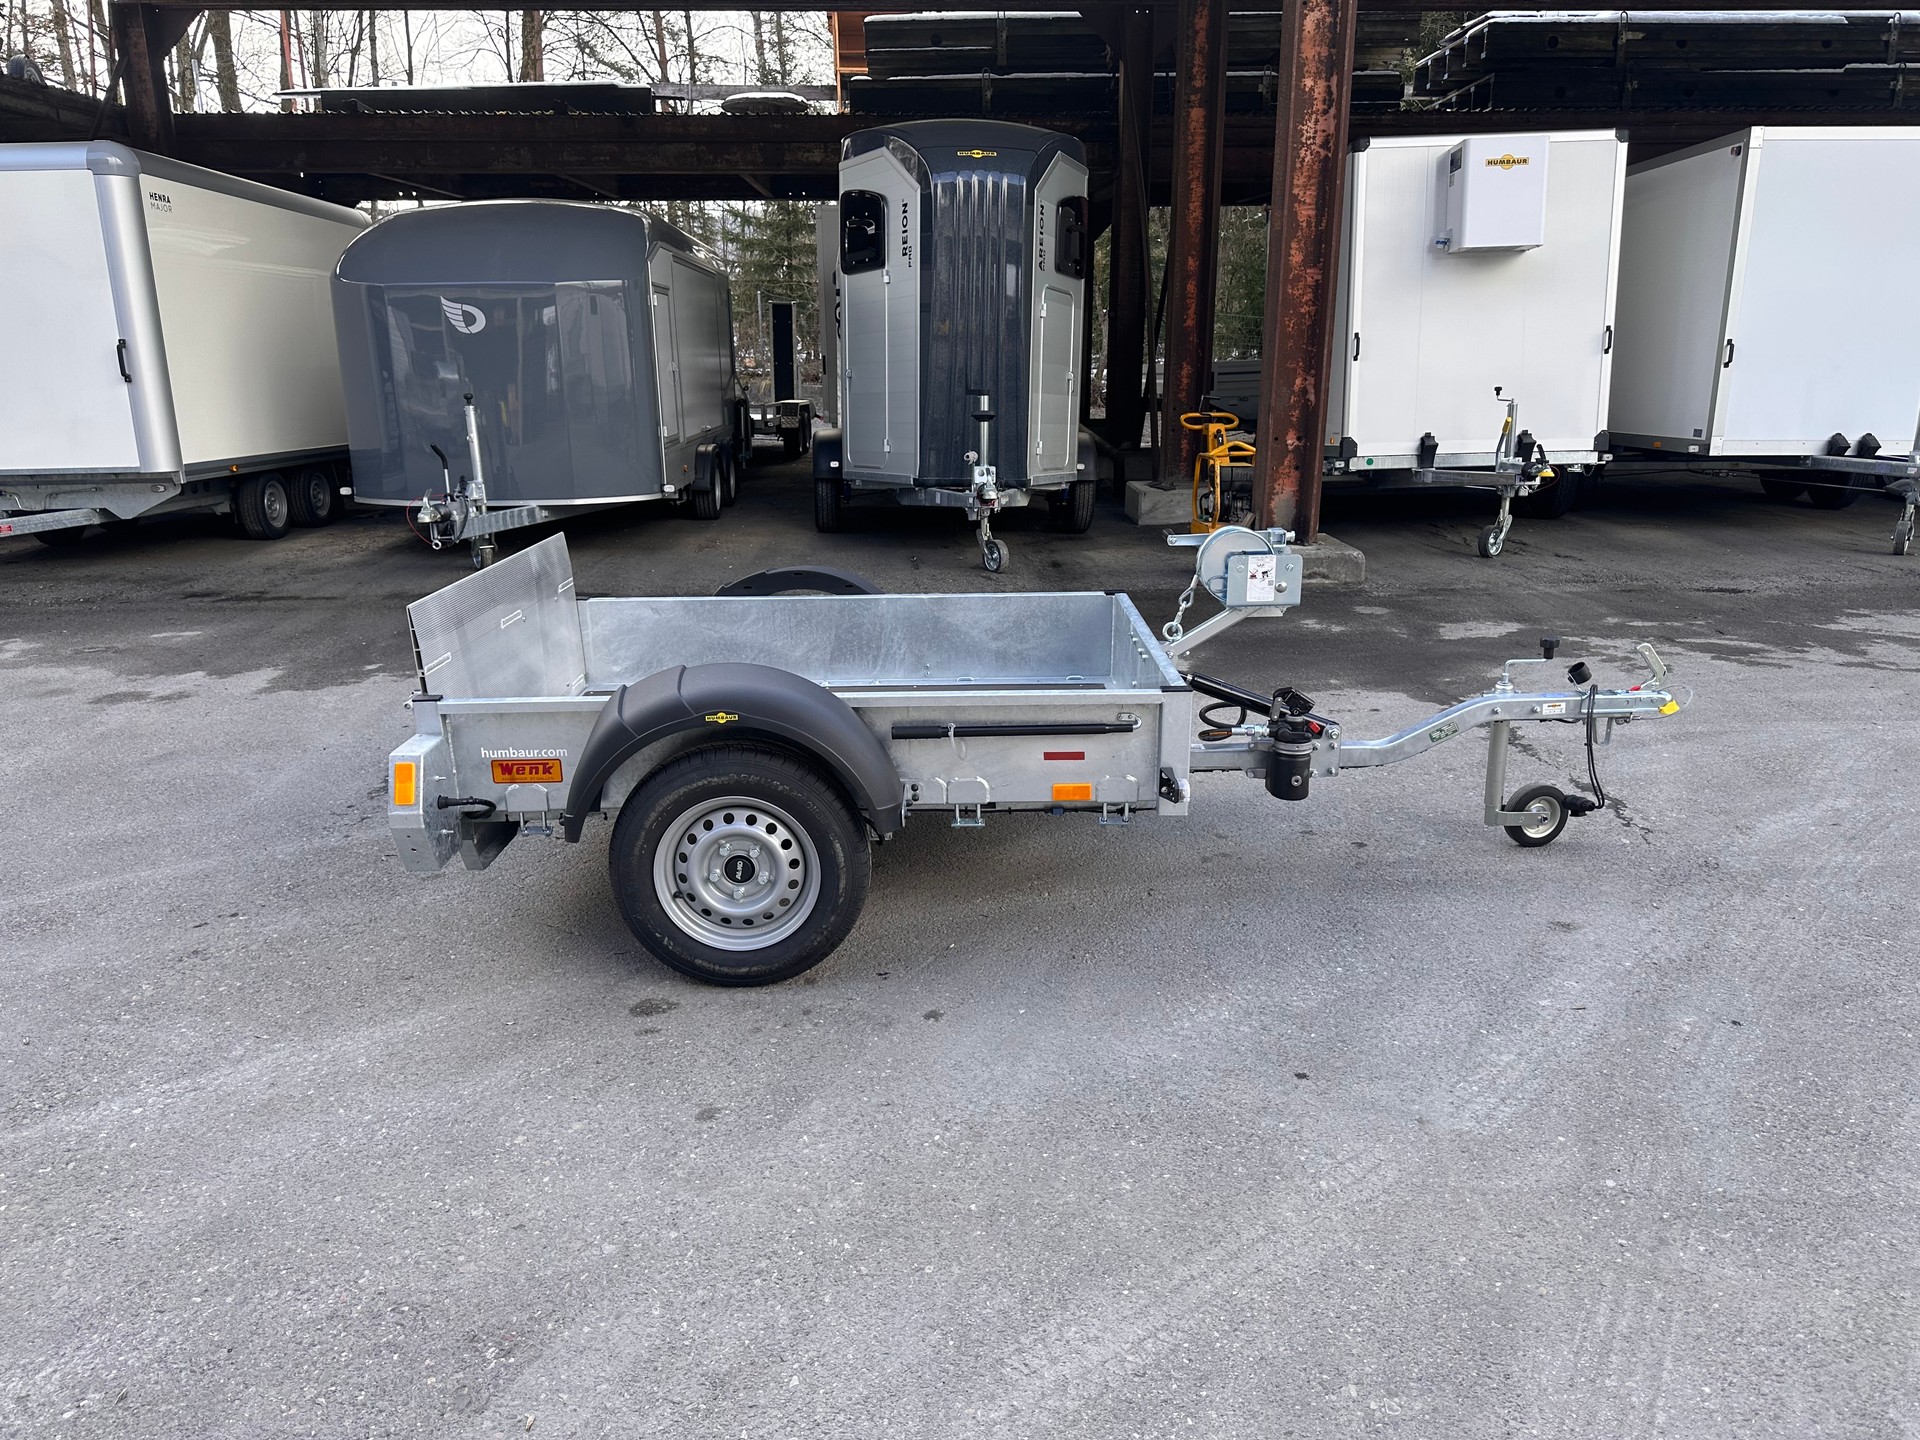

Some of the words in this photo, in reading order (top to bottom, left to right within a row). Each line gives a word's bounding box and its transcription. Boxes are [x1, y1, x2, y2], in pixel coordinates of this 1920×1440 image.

[1487, 158, 1528, 166] HUMBAUR
[149, 191, 171, 204] HENRA
[150, 201, 173, 213] MAJOR
[480, 747, 568, 758] humbaur.com
[498, 762, 555, 776] Wenk
